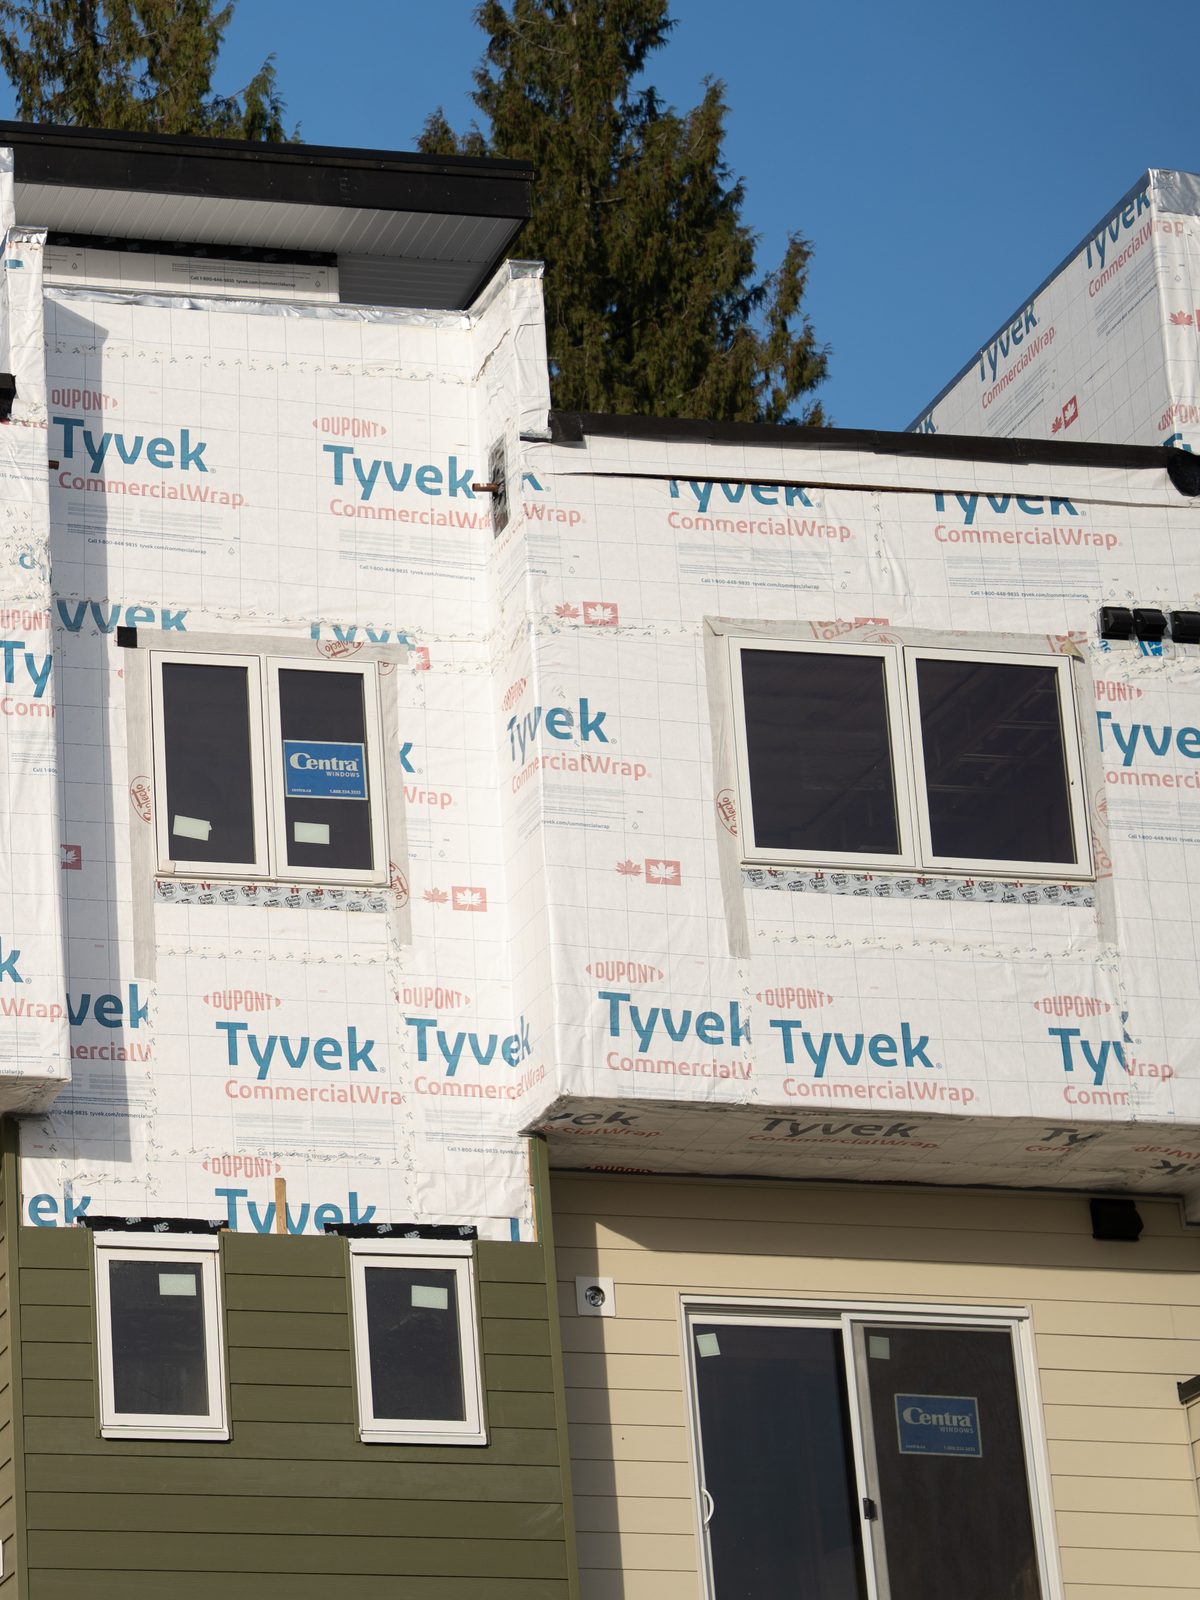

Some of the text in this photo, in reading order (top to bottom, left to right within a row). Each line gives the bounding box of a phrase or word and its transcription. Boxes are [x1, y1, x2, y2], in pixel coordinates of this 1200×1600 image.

[981, 325, 1056, 410] CommercialWrap
[51, 389, 110, 411] DUPONT
[321, 416, 379, 438] DUPONT
[53, 416, 209, 474] Tyvek
[323, 444, 477, 500] Tyvek
[59, 472, 245, 510] CommercialWrap
[668, 511, 851, 542] CommercialWrap
[934, 525, 1119, 551] CommercialWrap
[507, 697, 609, 765] Tyvek
[290, 752, 359, 771] Centra
[511, 752, 647, 794] CommercialWrap
[595, 960, 656, 984] DUPONT
[212, 989, 273, 1012] DUPONT
[402, 986, 463, 1009] DUPONT
[766, 987, 825, 1009] DUPONT
[1043, 995, 1102, 1018] DUPONT
[215, 1021, 379, 1080] Tyvek
[405, 1015, 532, 1077] Tyvek
[769, 1019, 935, 1078] Tyvek
[783, 1078, 975, 1106] CommercialWrap
[762, 1117, 921, 1138] Tyvek
[748, 1134, 939, 1150] CommercialWrap
[212, 1155, 272, 1178] DUPONT
[153, 1222, 170, 1232] 3M
[376, 1223, 393, 1234] 3M
[458, 1225, 475, 1236] 3M
[902, 1406, 972, 1427] Centra
